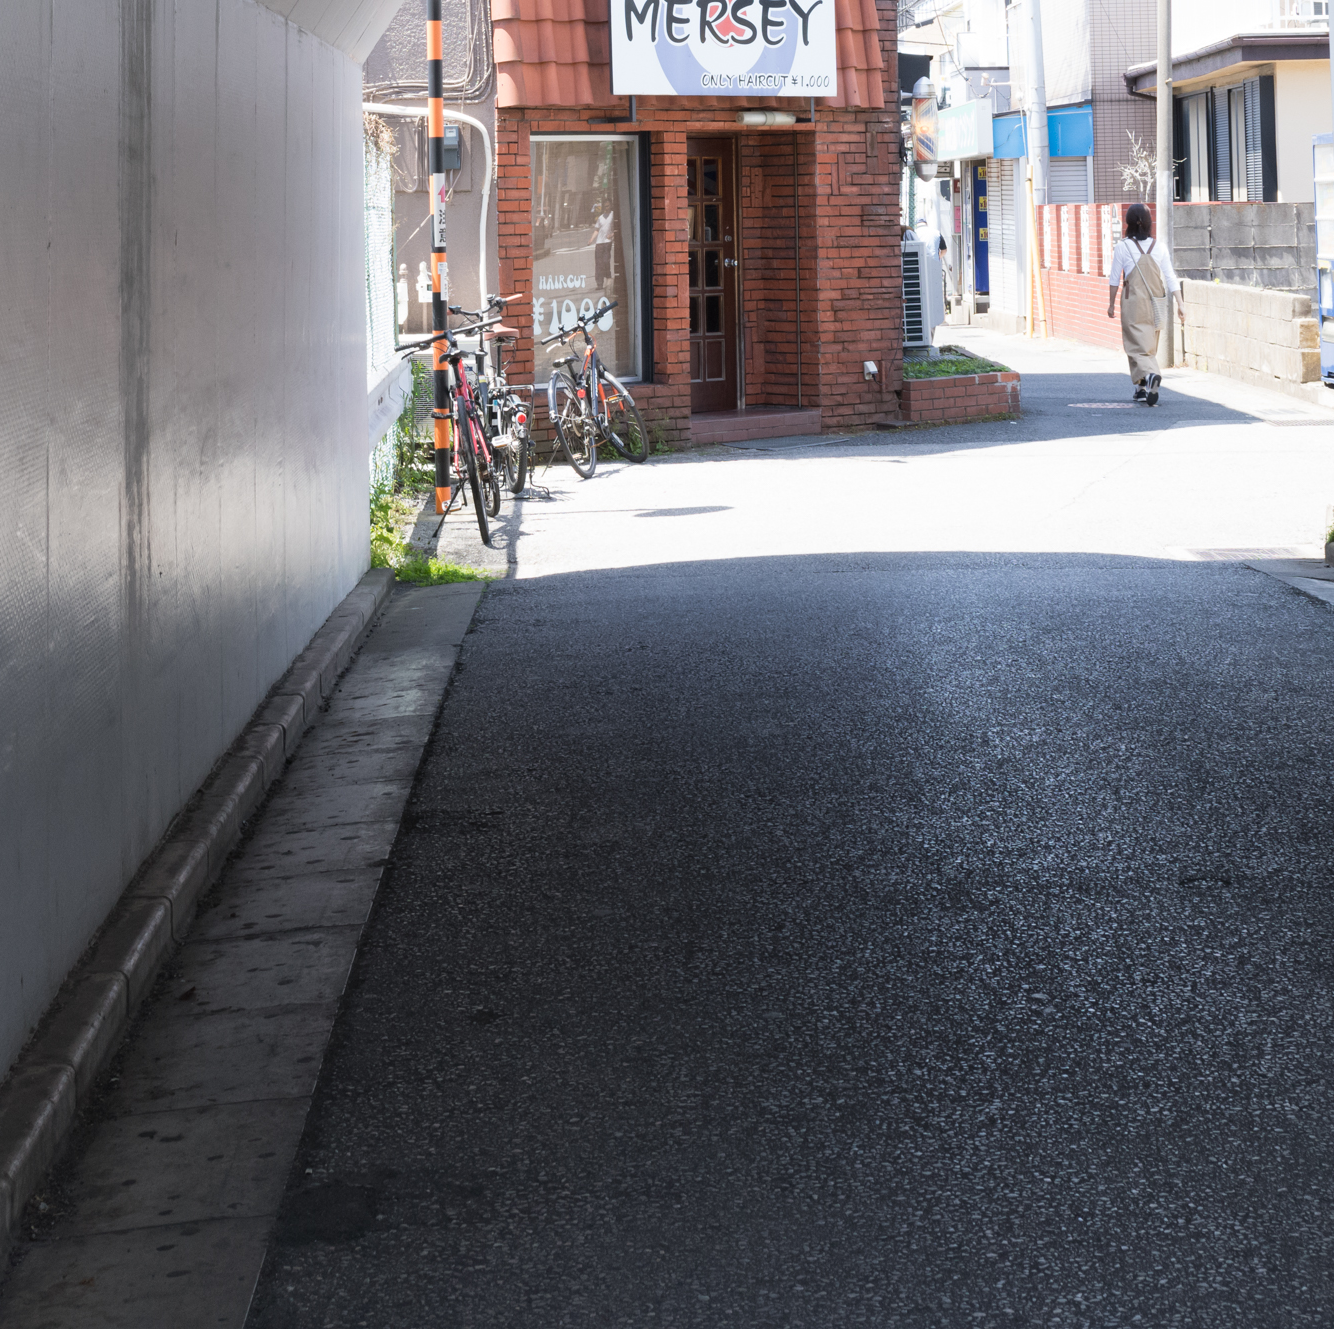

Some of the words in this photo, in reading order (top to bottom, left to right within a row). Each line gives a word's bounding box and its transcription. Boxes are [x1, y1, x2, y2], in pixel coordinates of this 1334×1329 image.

[702, 74, 735, 87] ONLY
[738, 74, 788, 88] HAIRCUT
[539, 275, 586, 290] HAIRCUT
